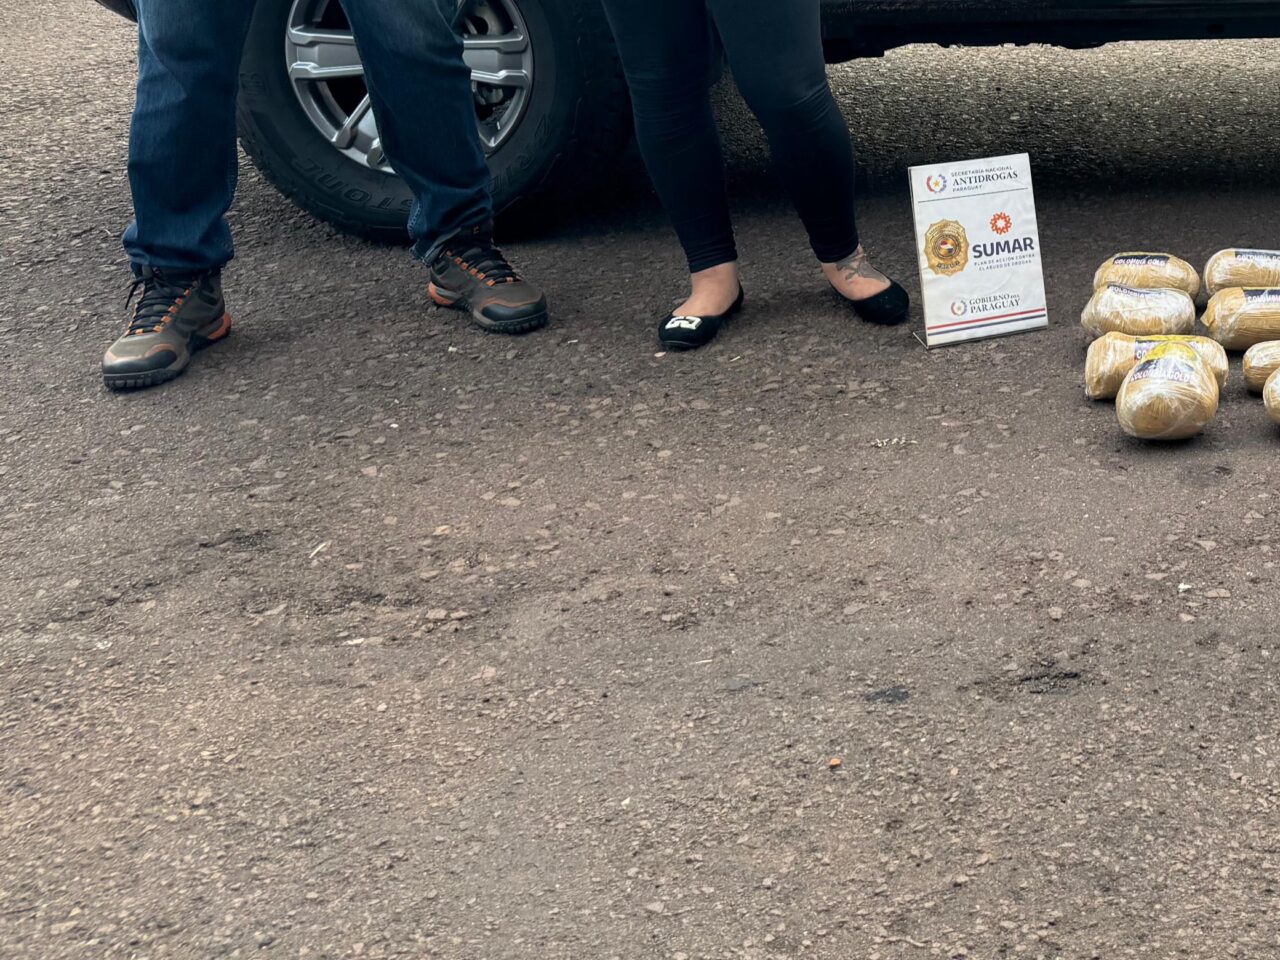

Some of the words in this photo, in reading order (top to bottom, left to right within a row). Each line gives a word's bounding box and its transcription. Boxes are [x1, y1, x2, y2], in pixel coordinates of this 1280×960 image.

[953, 171, 1018, 186] ANTIDROGAS
[952, 185, 983, 193] PARAGUAY
[972, 237, 1034, 259] SUMAR
[969, 294, 1009, 305] GOBIERNO
[970, 299, 1020, 314] PARAGUAY
